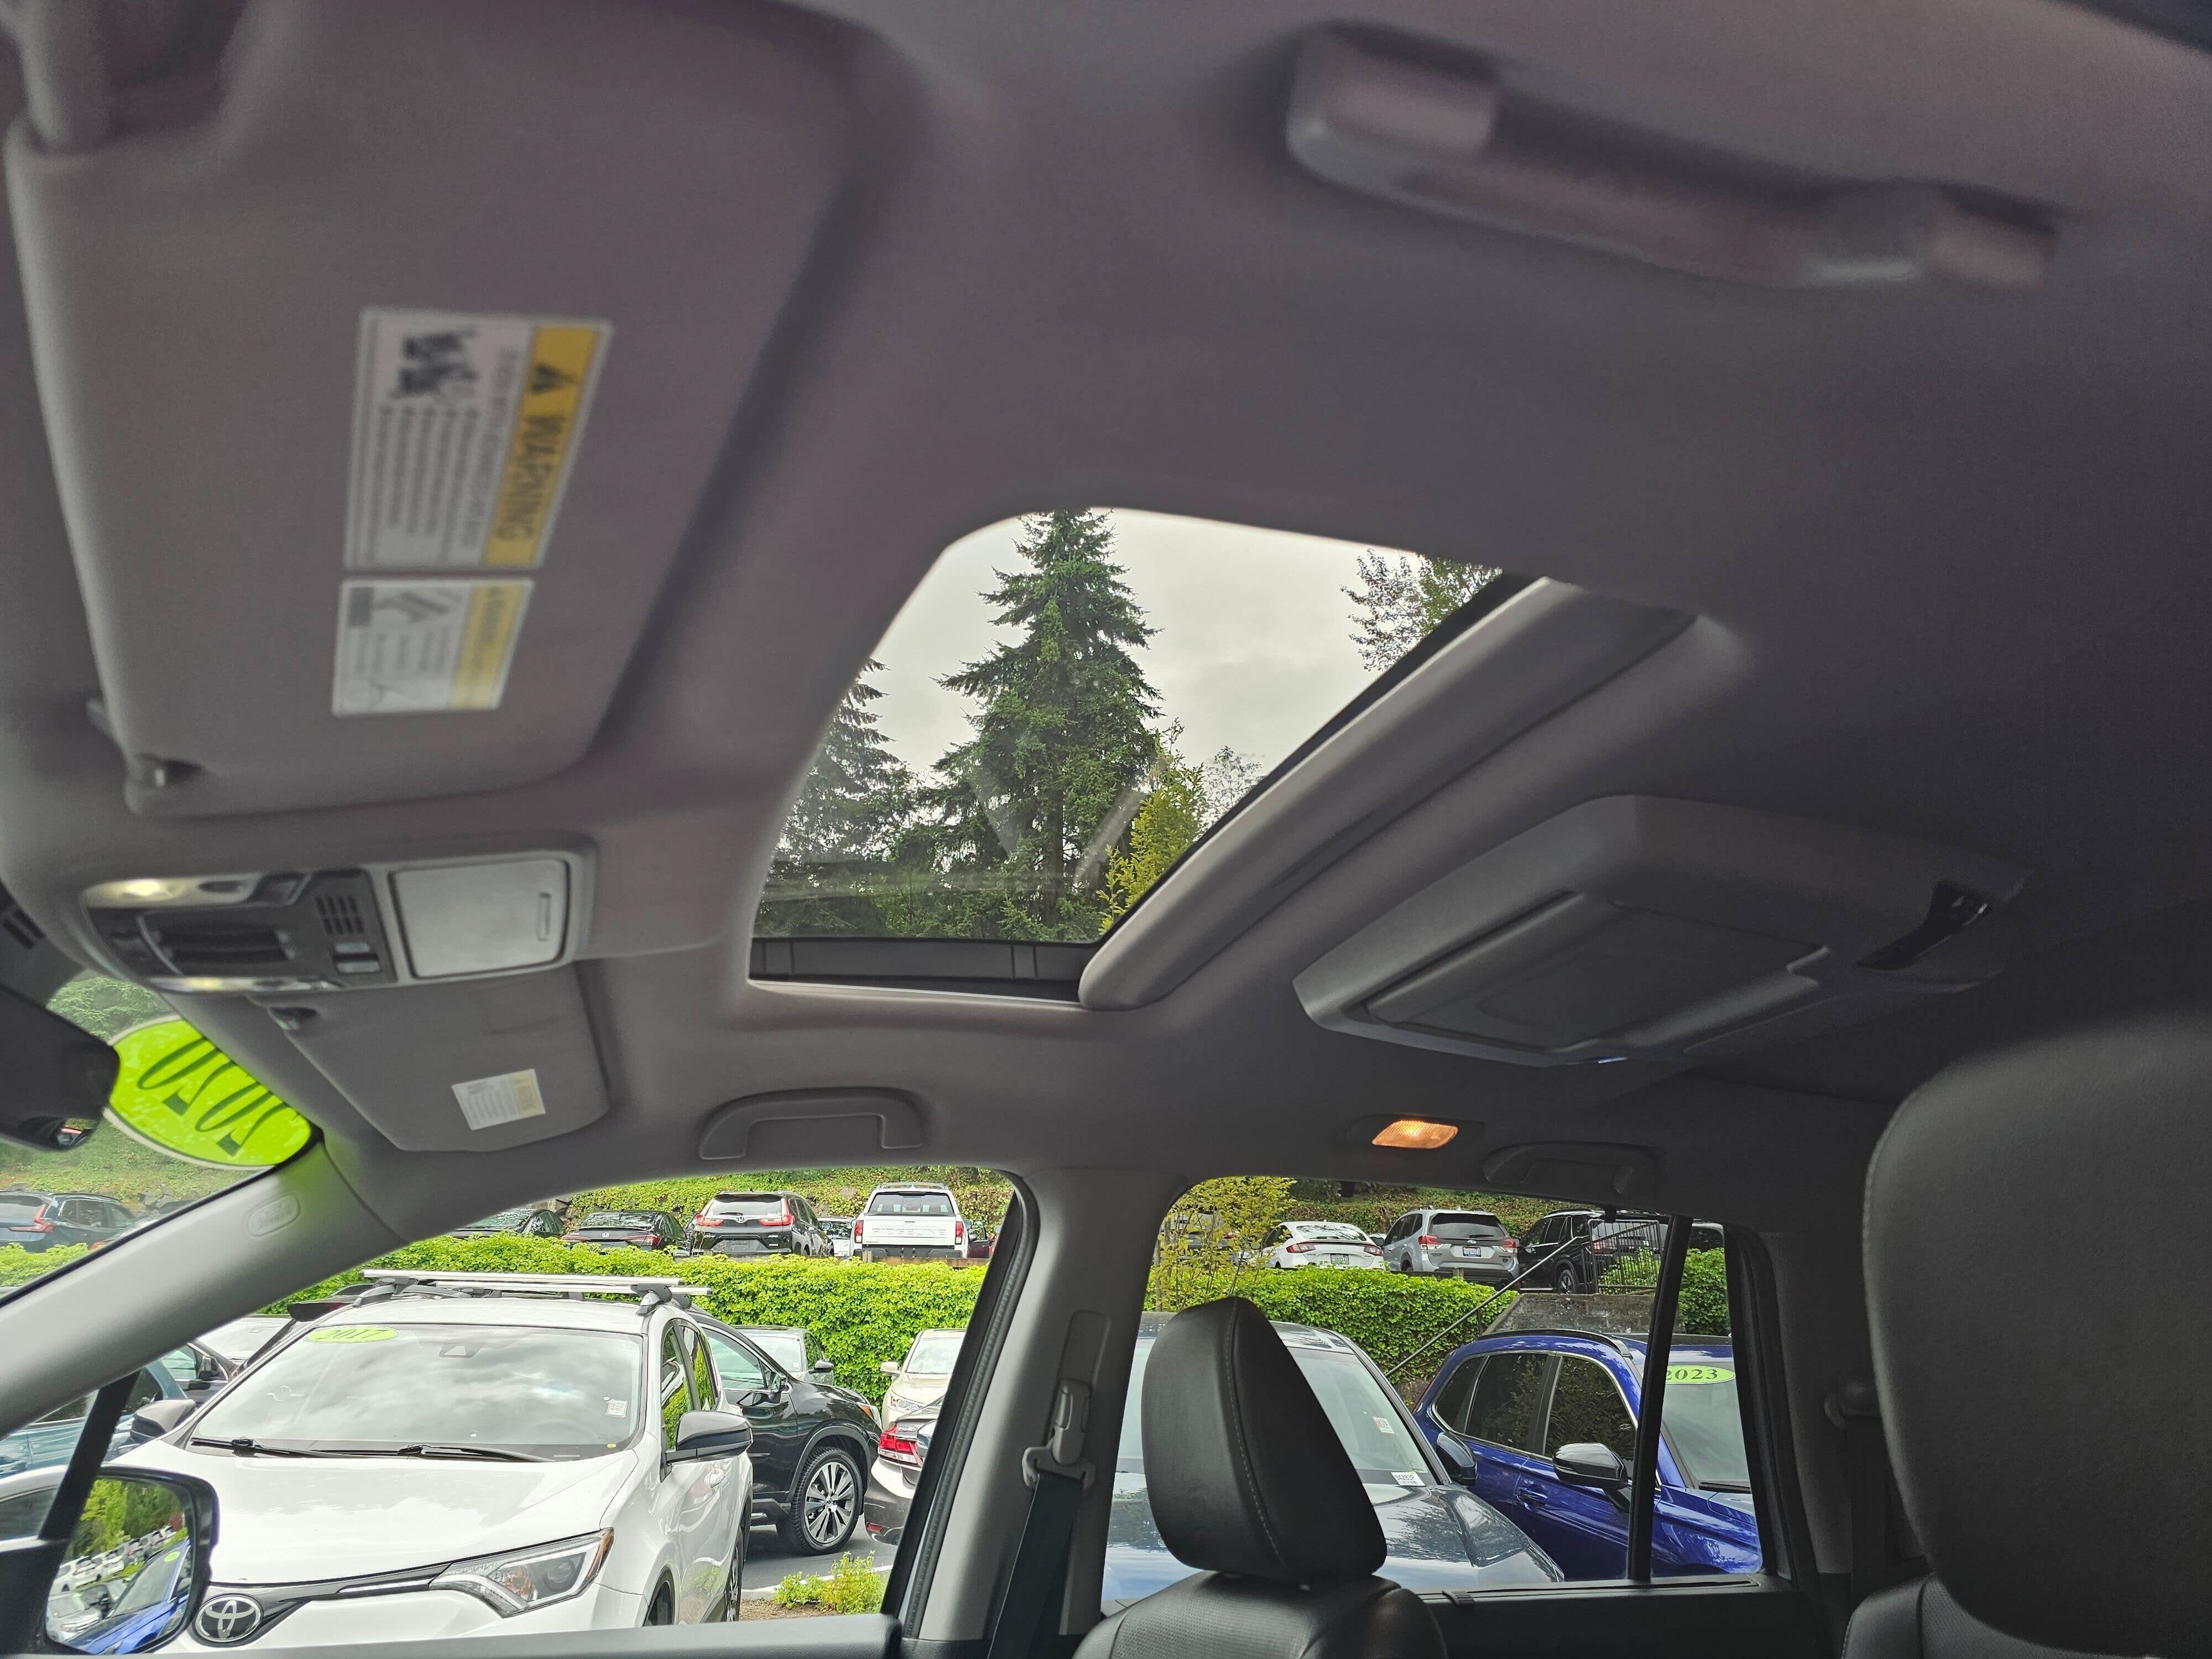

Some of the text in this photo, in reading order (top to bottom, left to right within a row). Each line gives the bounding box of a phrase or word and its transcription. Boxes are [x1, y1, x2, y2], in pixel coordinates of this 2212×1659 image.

[497, 414, 565, 542] WARNING
[314, 1329, 388, 1340] 2017
[1666, 1369, 1718, 1380] 2023
